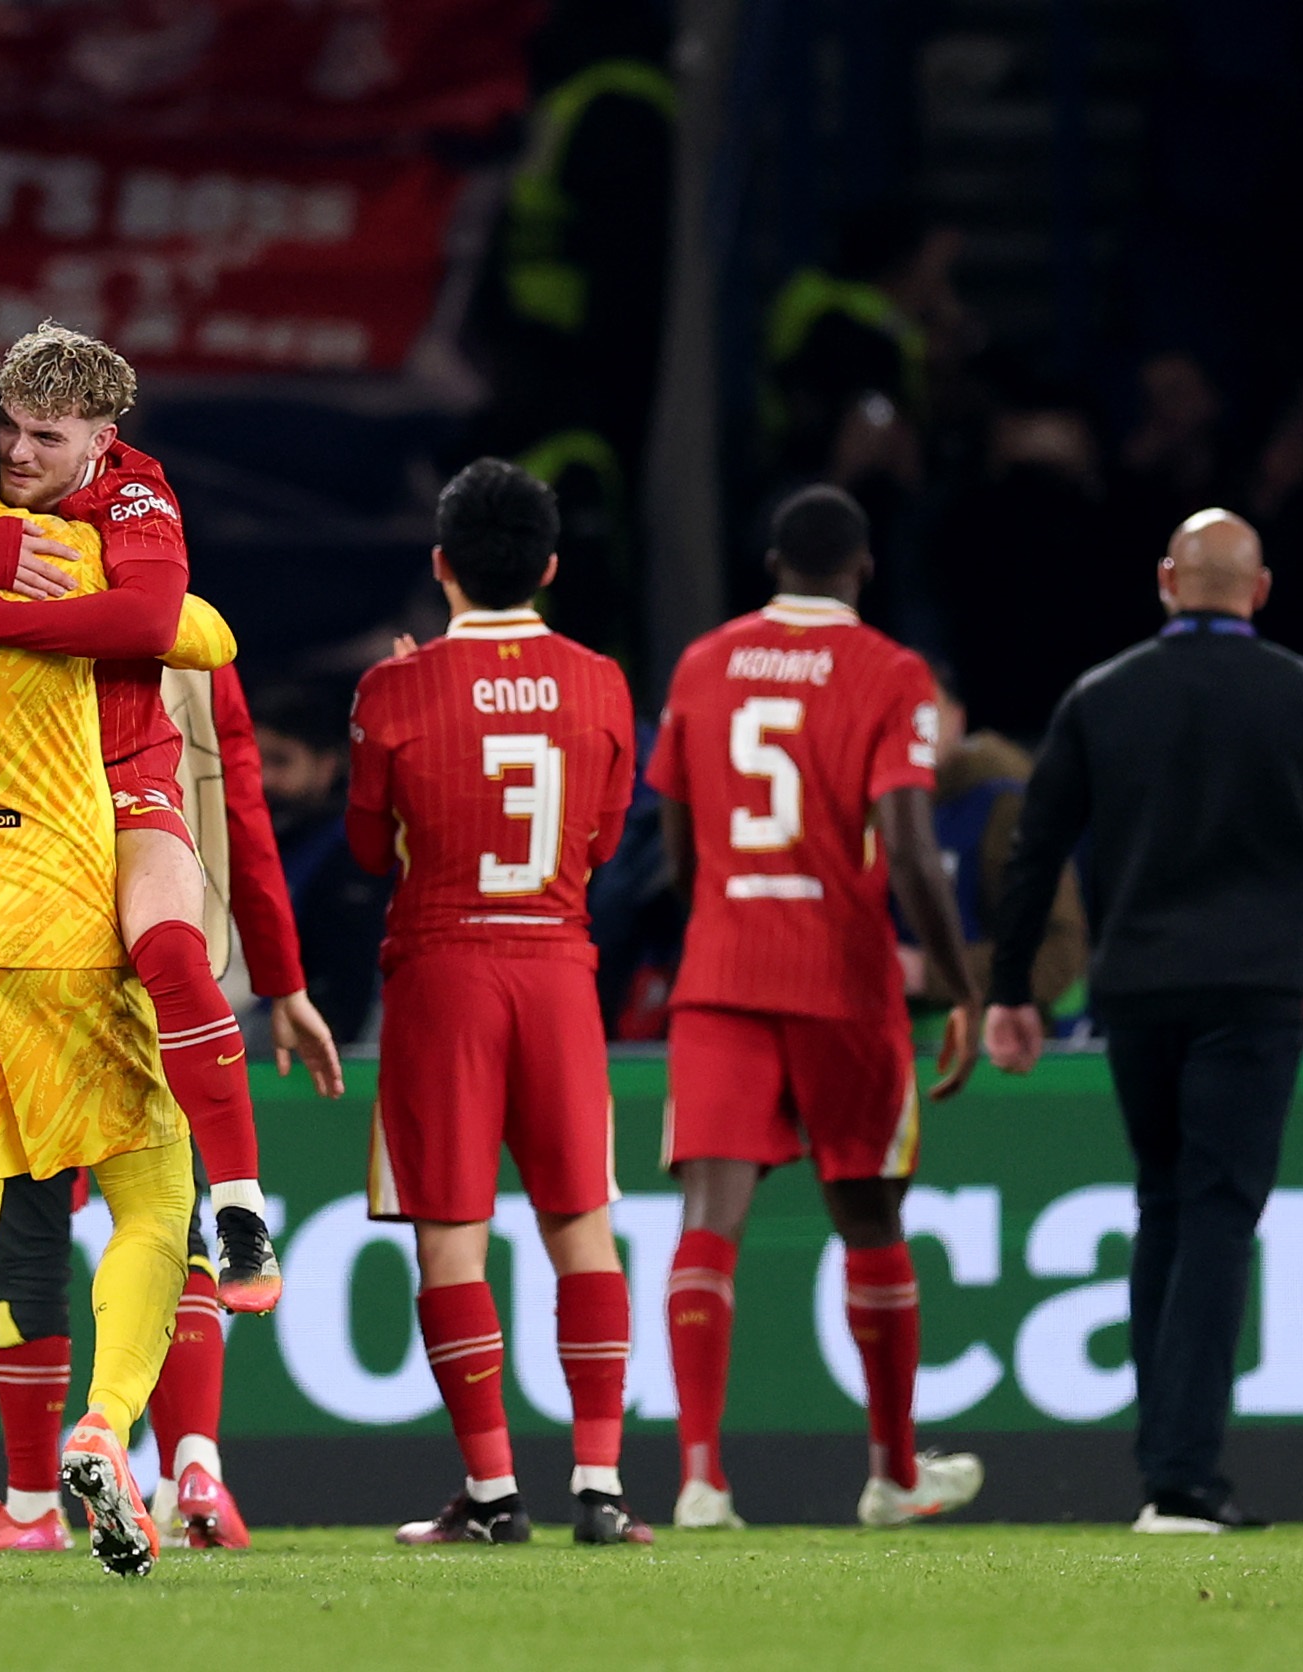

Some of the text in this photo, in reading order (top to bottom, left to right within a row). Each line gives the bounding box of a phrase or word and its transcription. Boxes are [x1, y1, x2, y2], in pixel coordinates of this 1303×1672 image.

[472, 676, 559, 713] ENDO
[478, 734, 566, 898] 3
[729, 696, 805, 853] 5
